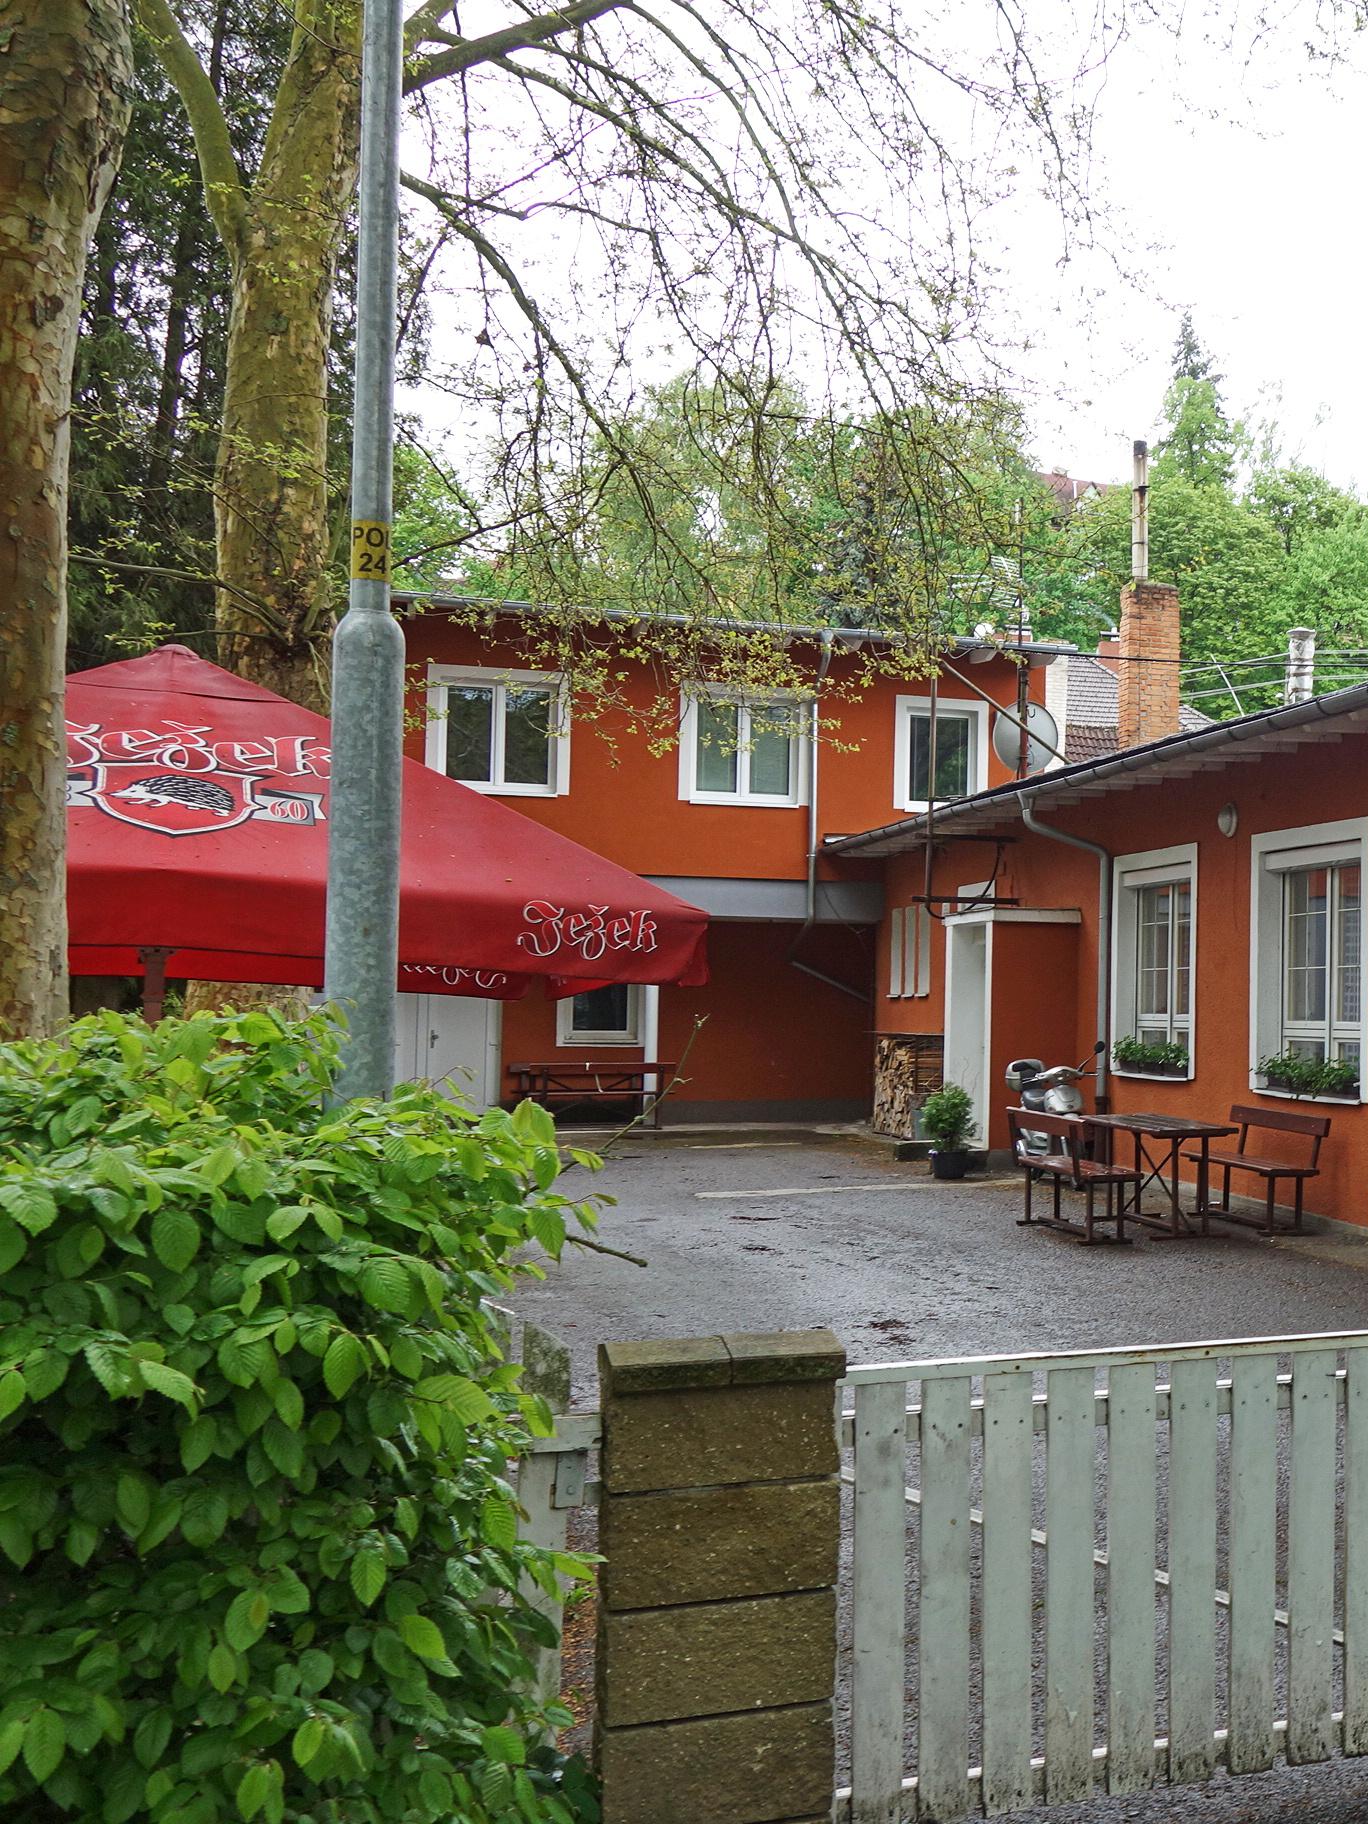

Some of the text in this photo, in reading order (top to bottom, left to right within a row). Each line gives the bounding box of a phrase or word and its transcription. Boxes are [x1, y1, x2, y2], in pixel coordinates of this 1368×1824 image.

[353, 527, 390, 549] POL
[358, 552, 387, 574] 24
[267, 799, 309, 820] 60
[516, 900, 658, 960] Ježek
